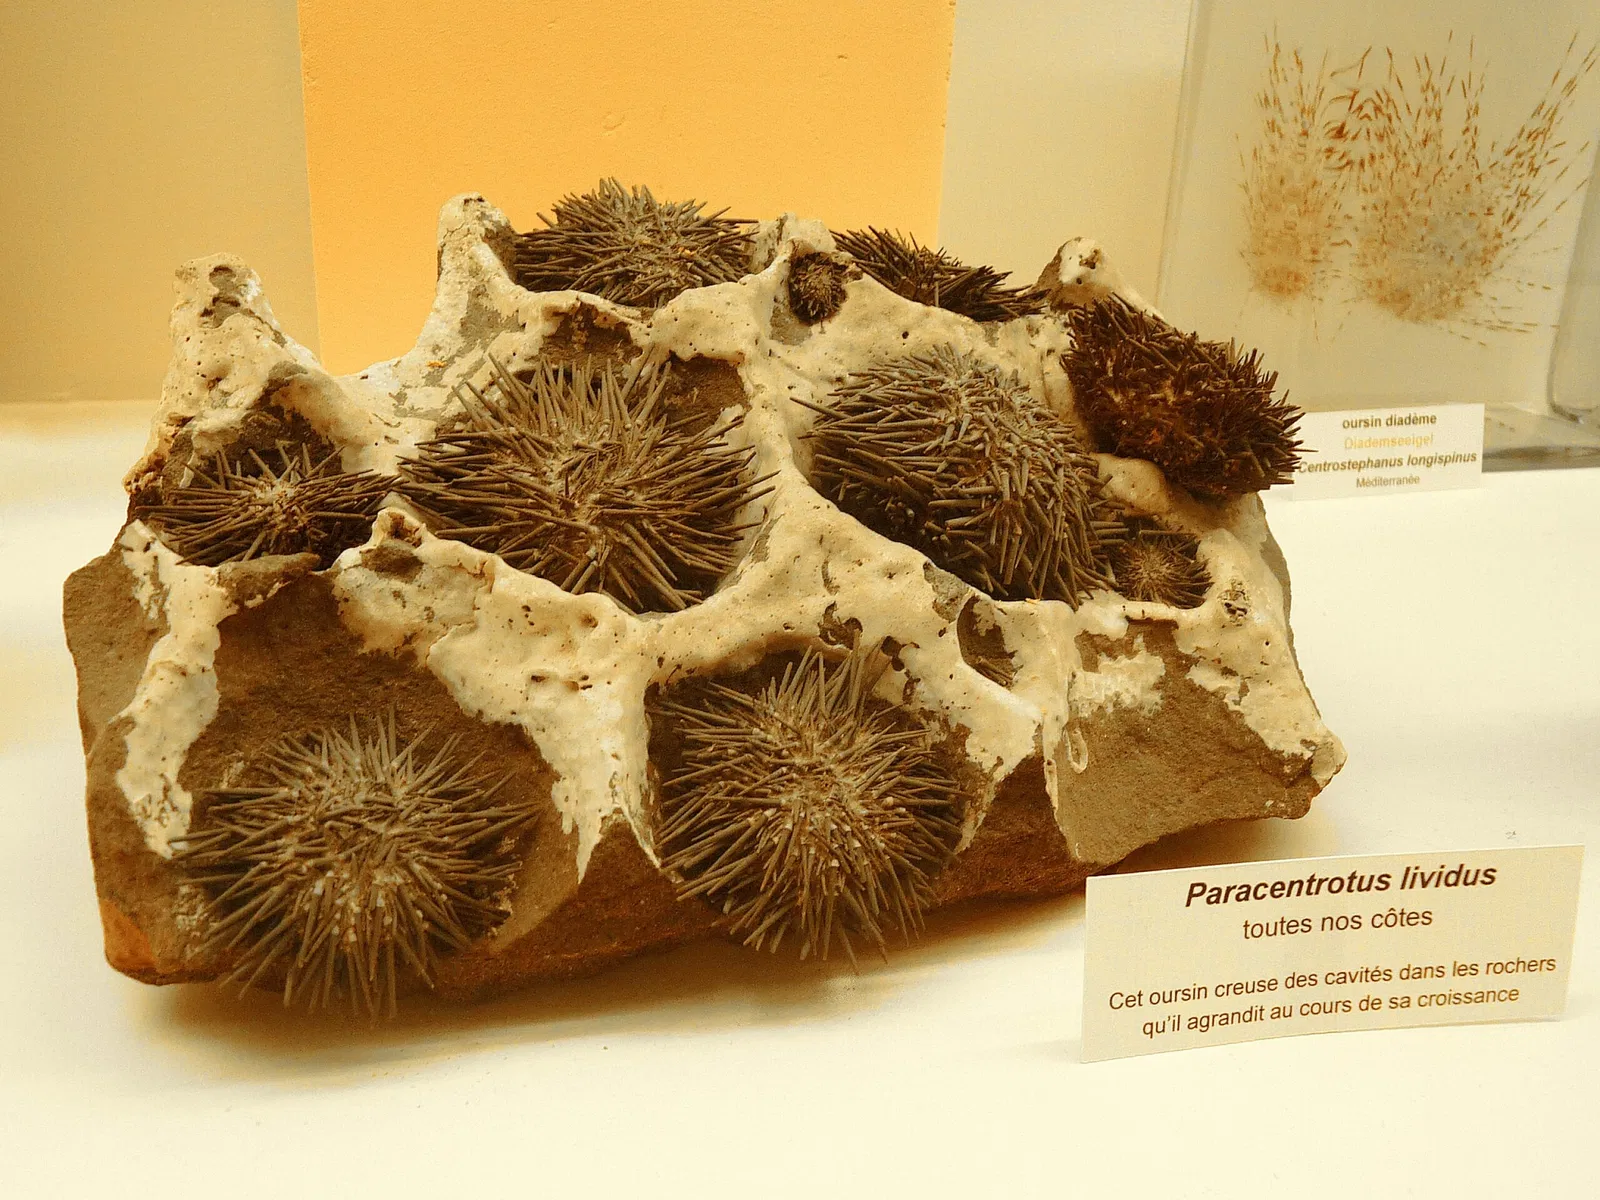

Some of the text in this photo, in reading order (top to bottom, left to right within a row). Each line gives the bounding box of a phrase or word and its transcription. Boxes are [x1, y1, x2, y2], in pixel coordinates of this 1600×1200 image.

[1342, 413, 1437, 429] oursin diadème
[1344, 434, 1434, 449] Diademseeigel
[1300, 451, 1477, 473] Centrostephanus longispinus
[1185, 863, 1497, 907] Paracentrotus lividus
[1243, 907, 1433, 939] toutes nos côtes
[1109, 957, 1556, 1010] Cet oursin creuse des cavités dans les rochers
[1142, 988, 1520, 1039] qu'il agrandit au cours de sa croissance
